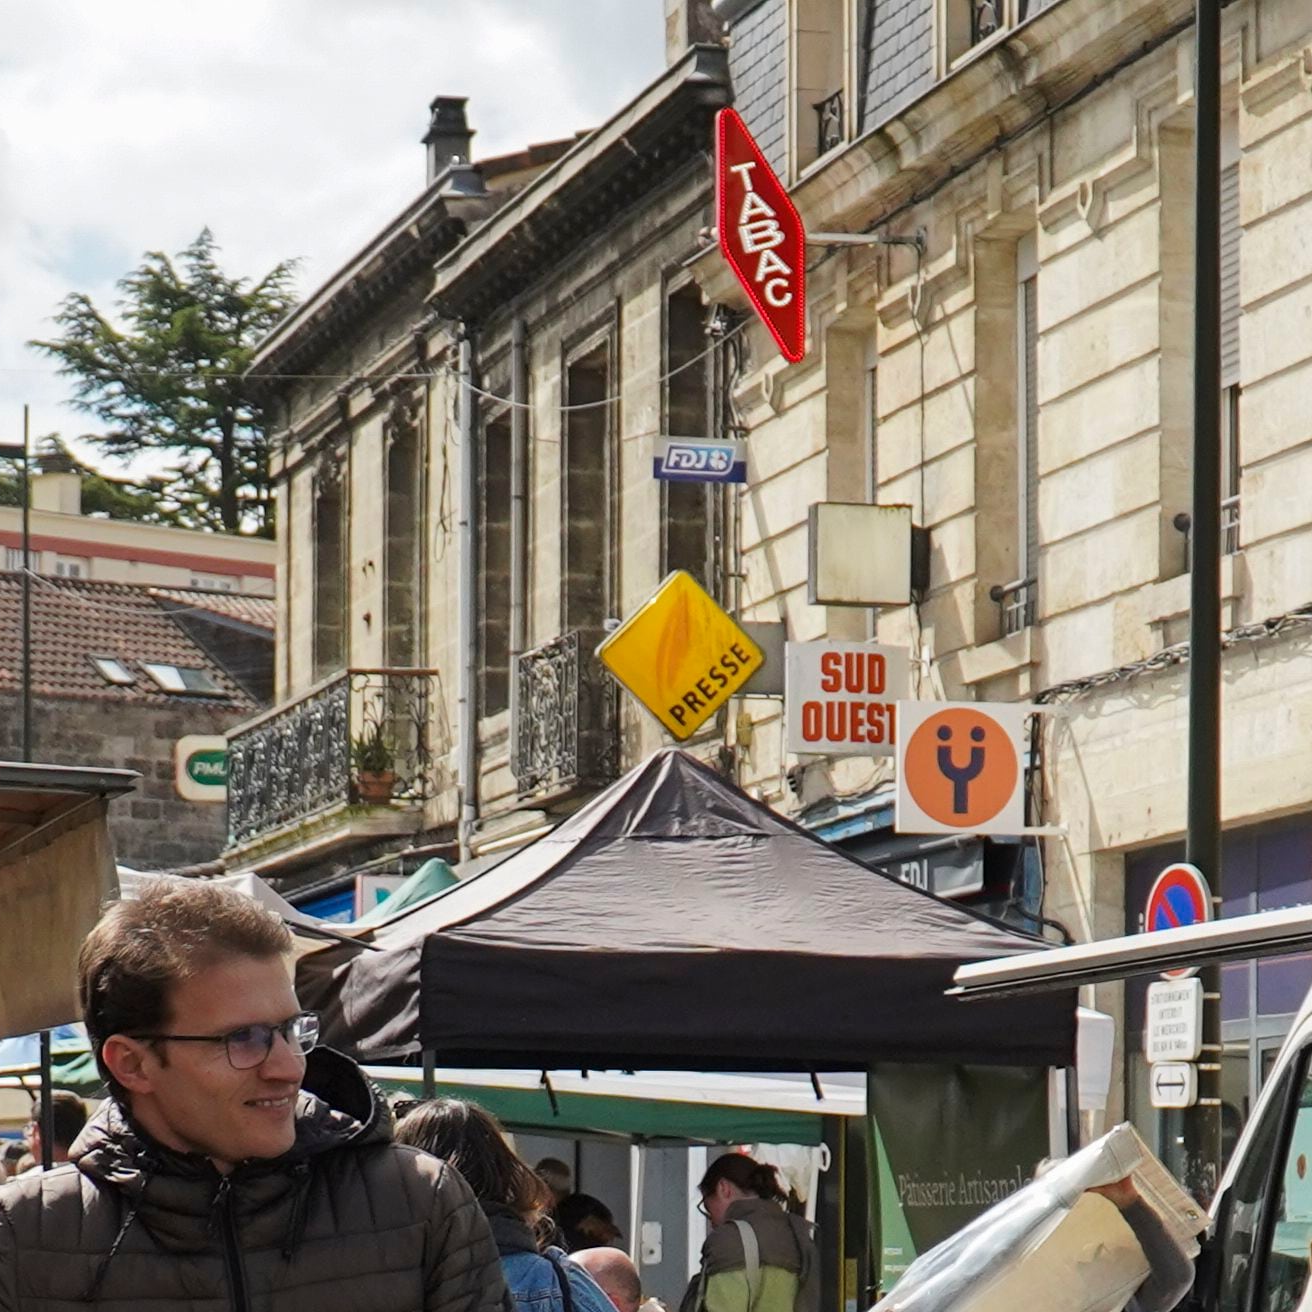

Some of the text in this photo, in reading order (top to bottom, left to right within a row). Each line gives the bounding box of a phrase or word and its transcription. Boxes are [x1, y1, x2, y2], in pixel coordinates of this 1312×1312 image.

[730, 161, 793, 307] TABAC
[668, 448, 707, 469] FDJ
[669, 642, 750, 727] PRESSE
[821, 651, 886, 694] SUD
[898, 1172, 957, 1207] Pâtisserie
